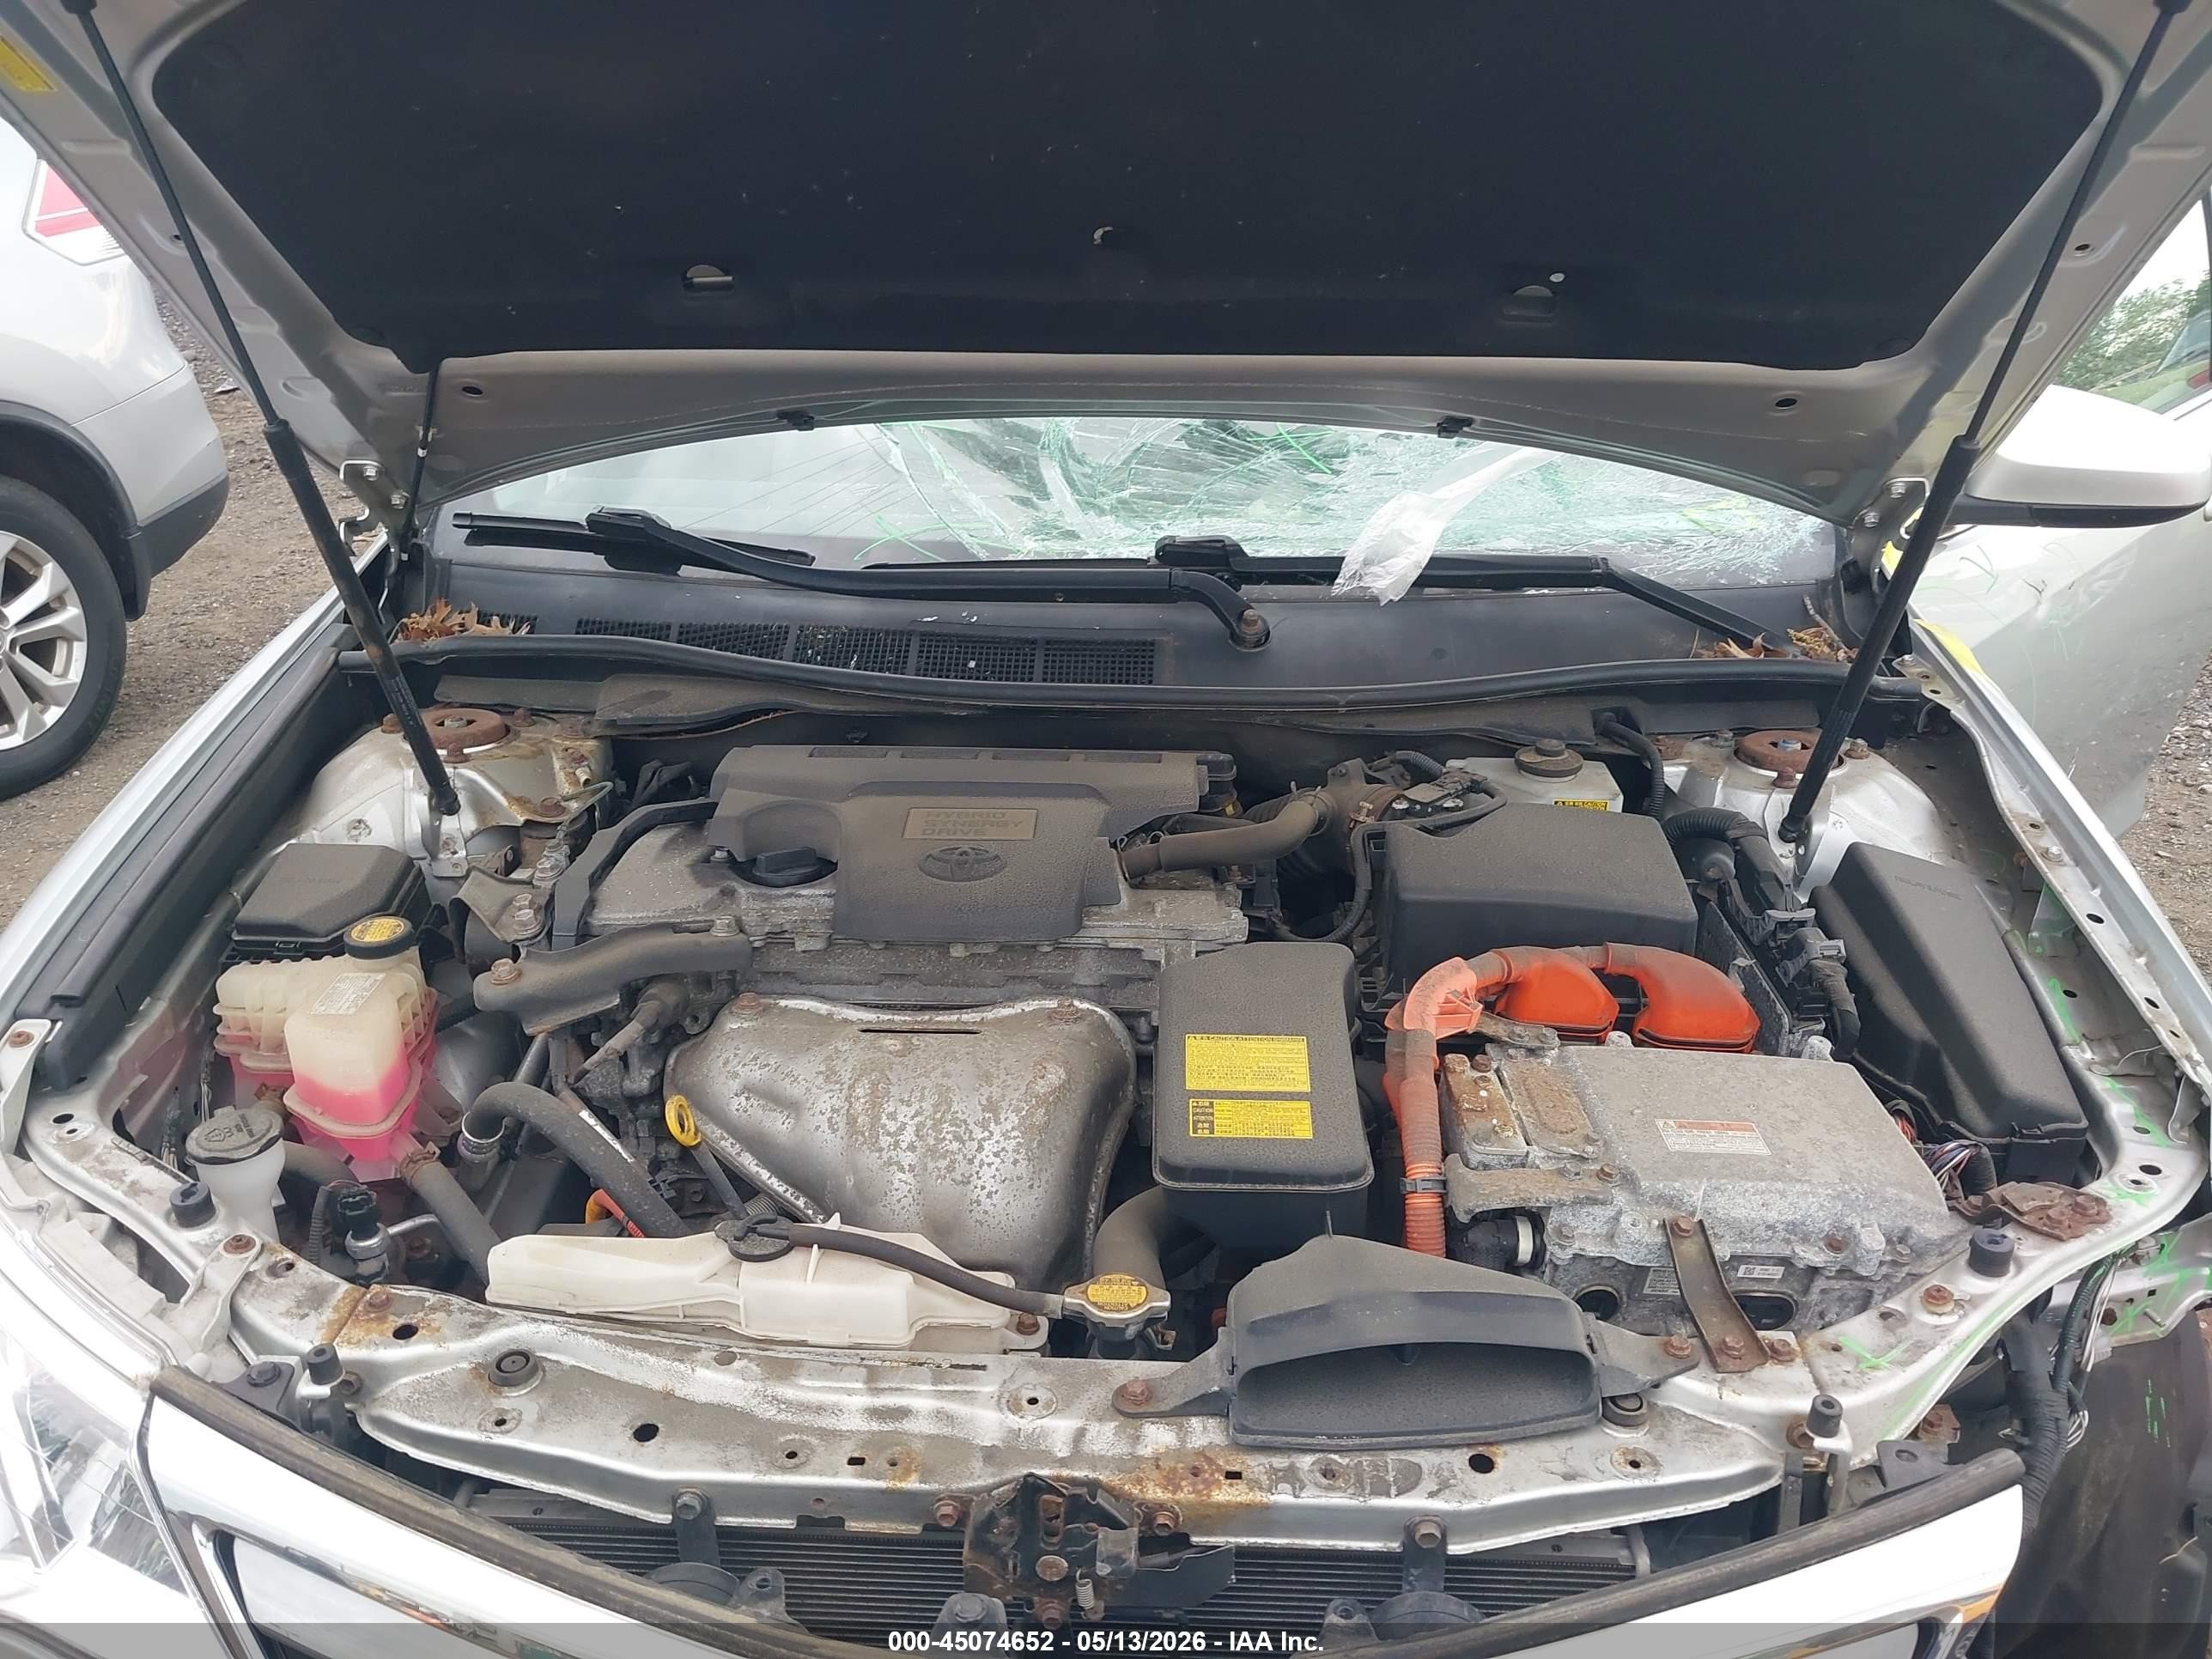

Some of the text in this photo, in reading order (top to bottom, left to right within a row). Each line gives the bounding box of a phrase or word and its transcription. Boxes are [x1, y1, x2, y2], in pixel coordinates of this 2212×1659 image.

[927, 811, 1007, 819] HYBRID
[924, 819, 1024, 828] SYNERGY
[921, 828, 987, 836] DRIVE
